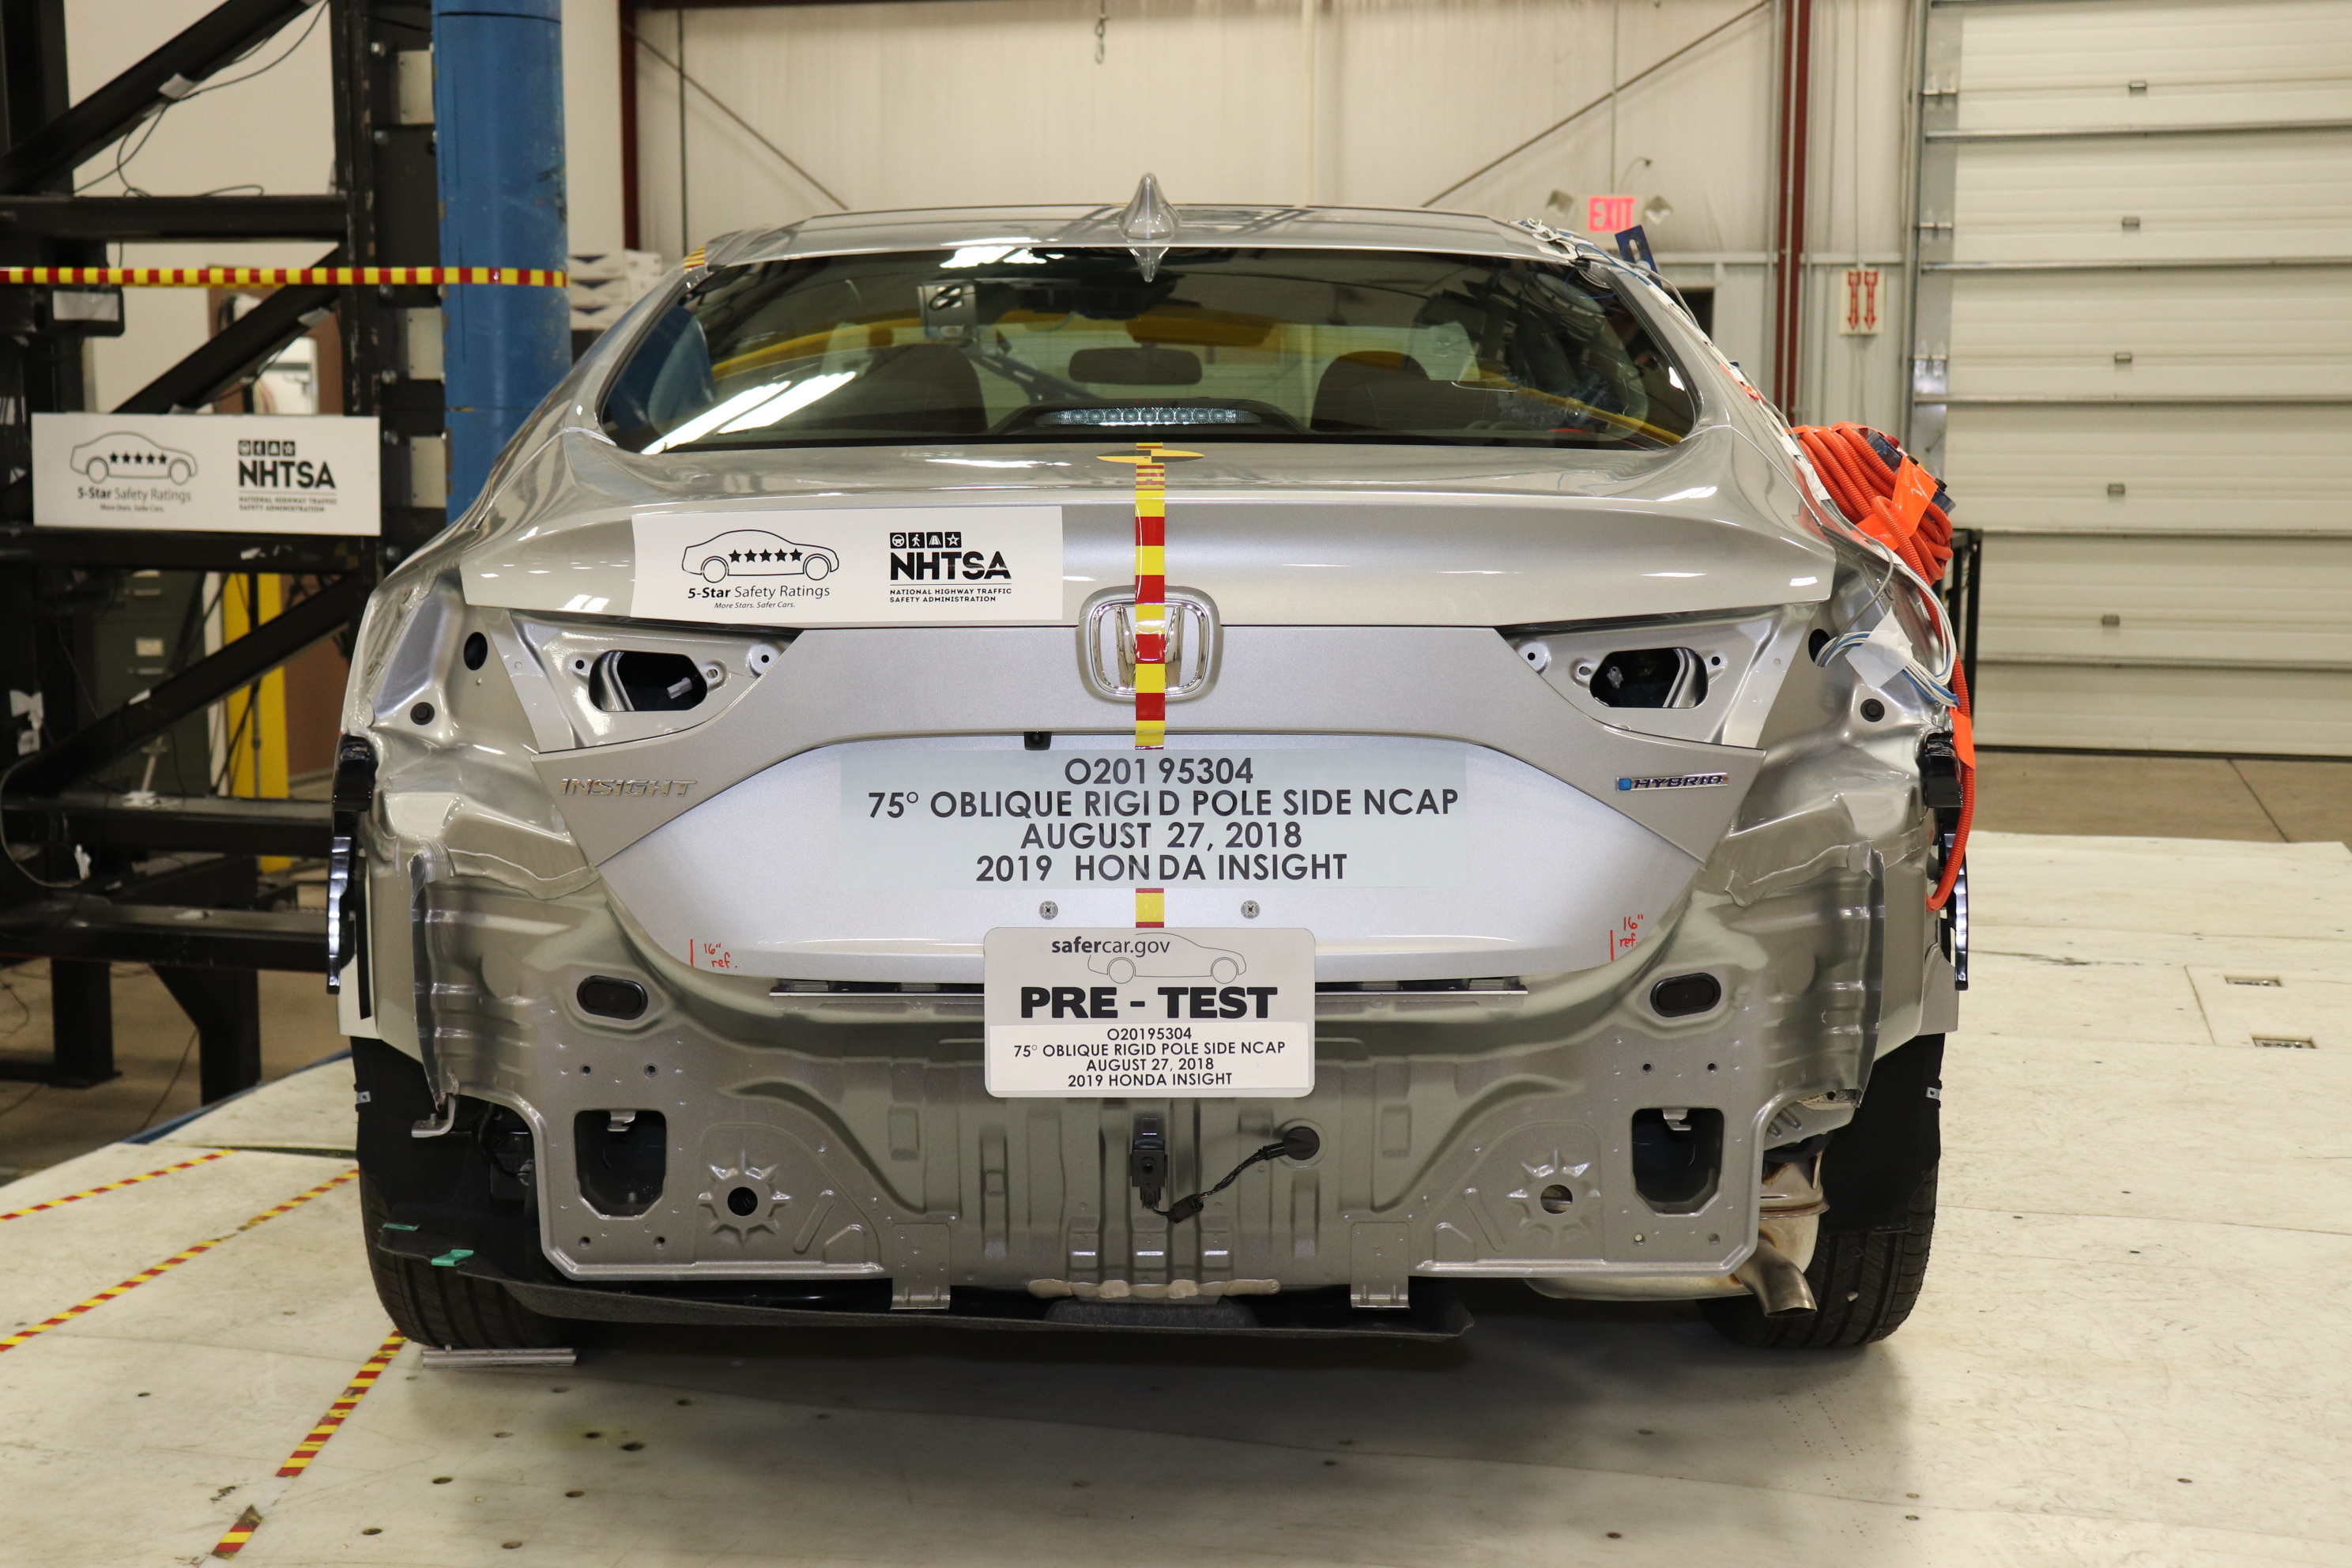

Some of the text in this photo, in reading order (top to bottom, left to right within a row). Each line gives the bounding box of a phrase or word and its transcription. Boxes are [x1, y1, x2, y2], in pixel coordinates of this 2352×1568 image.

[1589, 196, 1635, 232] EXIT
[239, 460, 336, 489] NHTSA
[77, 487, 191, 504] 5-Star Safety Ratings
[890, 551, 1012, 581] NHTSA
[688, 585, 831, 601] 5-Star Safety Ratings
[756, 601, 776, 609] Safer
[560, 778, 697, 797] INSIGHT
[1634, 775, 1724, 790] HYBRID
[868, 791, 919, 819] 75°
[930, 790, 1072, 819] OBLIQUE
[1193, 790, 1272, 817] POLE
[1283, 789, 1351, 816] SIDE
[1364, 788, 1458, 816] NCAP
[1020, 821, 1302, 852] AUGUST 27, 2018
[976, 853, 1348, 882] 2019 HONDA INSIGHT
[1051, 936, 1170, 958] safercar.gov
[1020, 986, 1118, 1019] PRE
[1157, 986, 1278, 1020] TEST
[1014, 1041, 1285, 1058] 75° OBLIQUE RIGID POLE SIDE NCAP
[1086, 1057, 1214, 1072] AUGUST 27, 2018
[1068, 1072, 1233, 1087] 2019 HONDA INSIGHT
